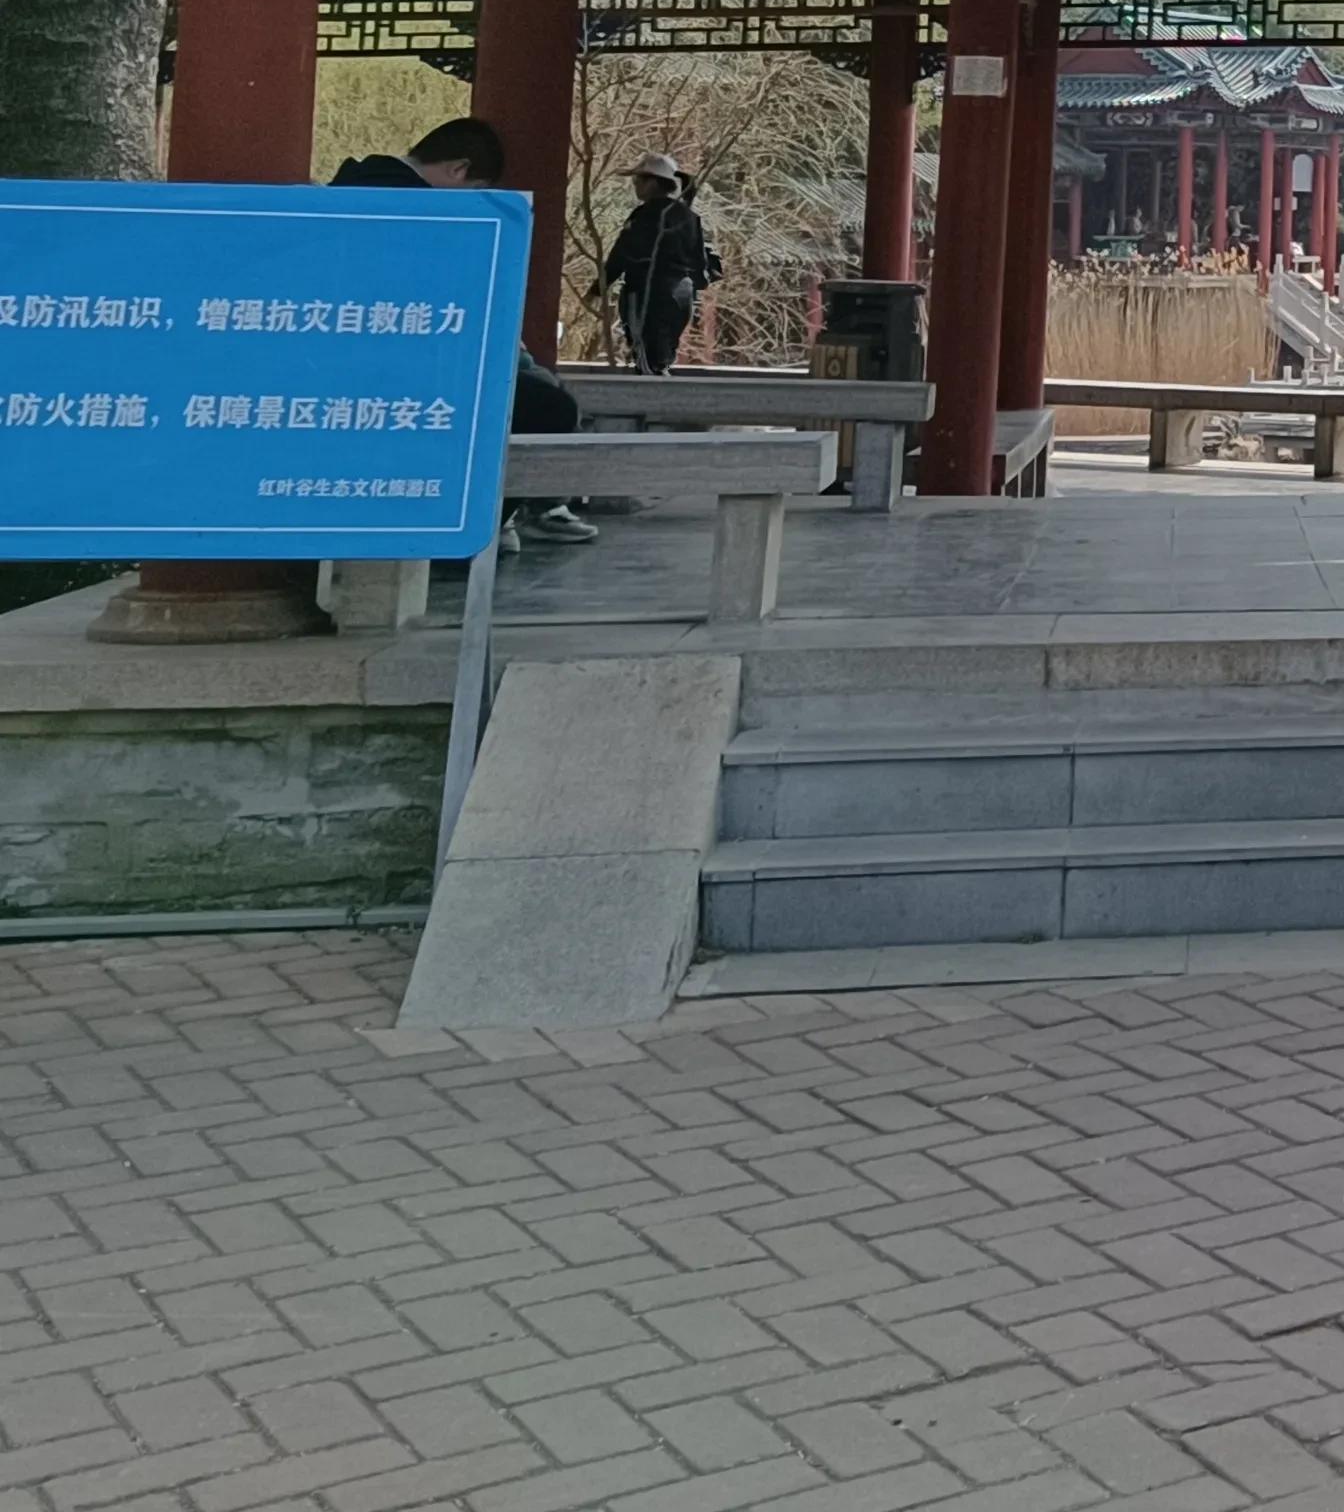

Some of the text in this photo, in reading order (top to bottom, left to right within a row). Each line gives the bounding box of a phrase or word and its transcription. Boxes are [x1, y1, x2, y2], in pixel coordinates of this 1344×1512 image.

[0, 392, 456, 431] 防火措施，保障景区消防安全
